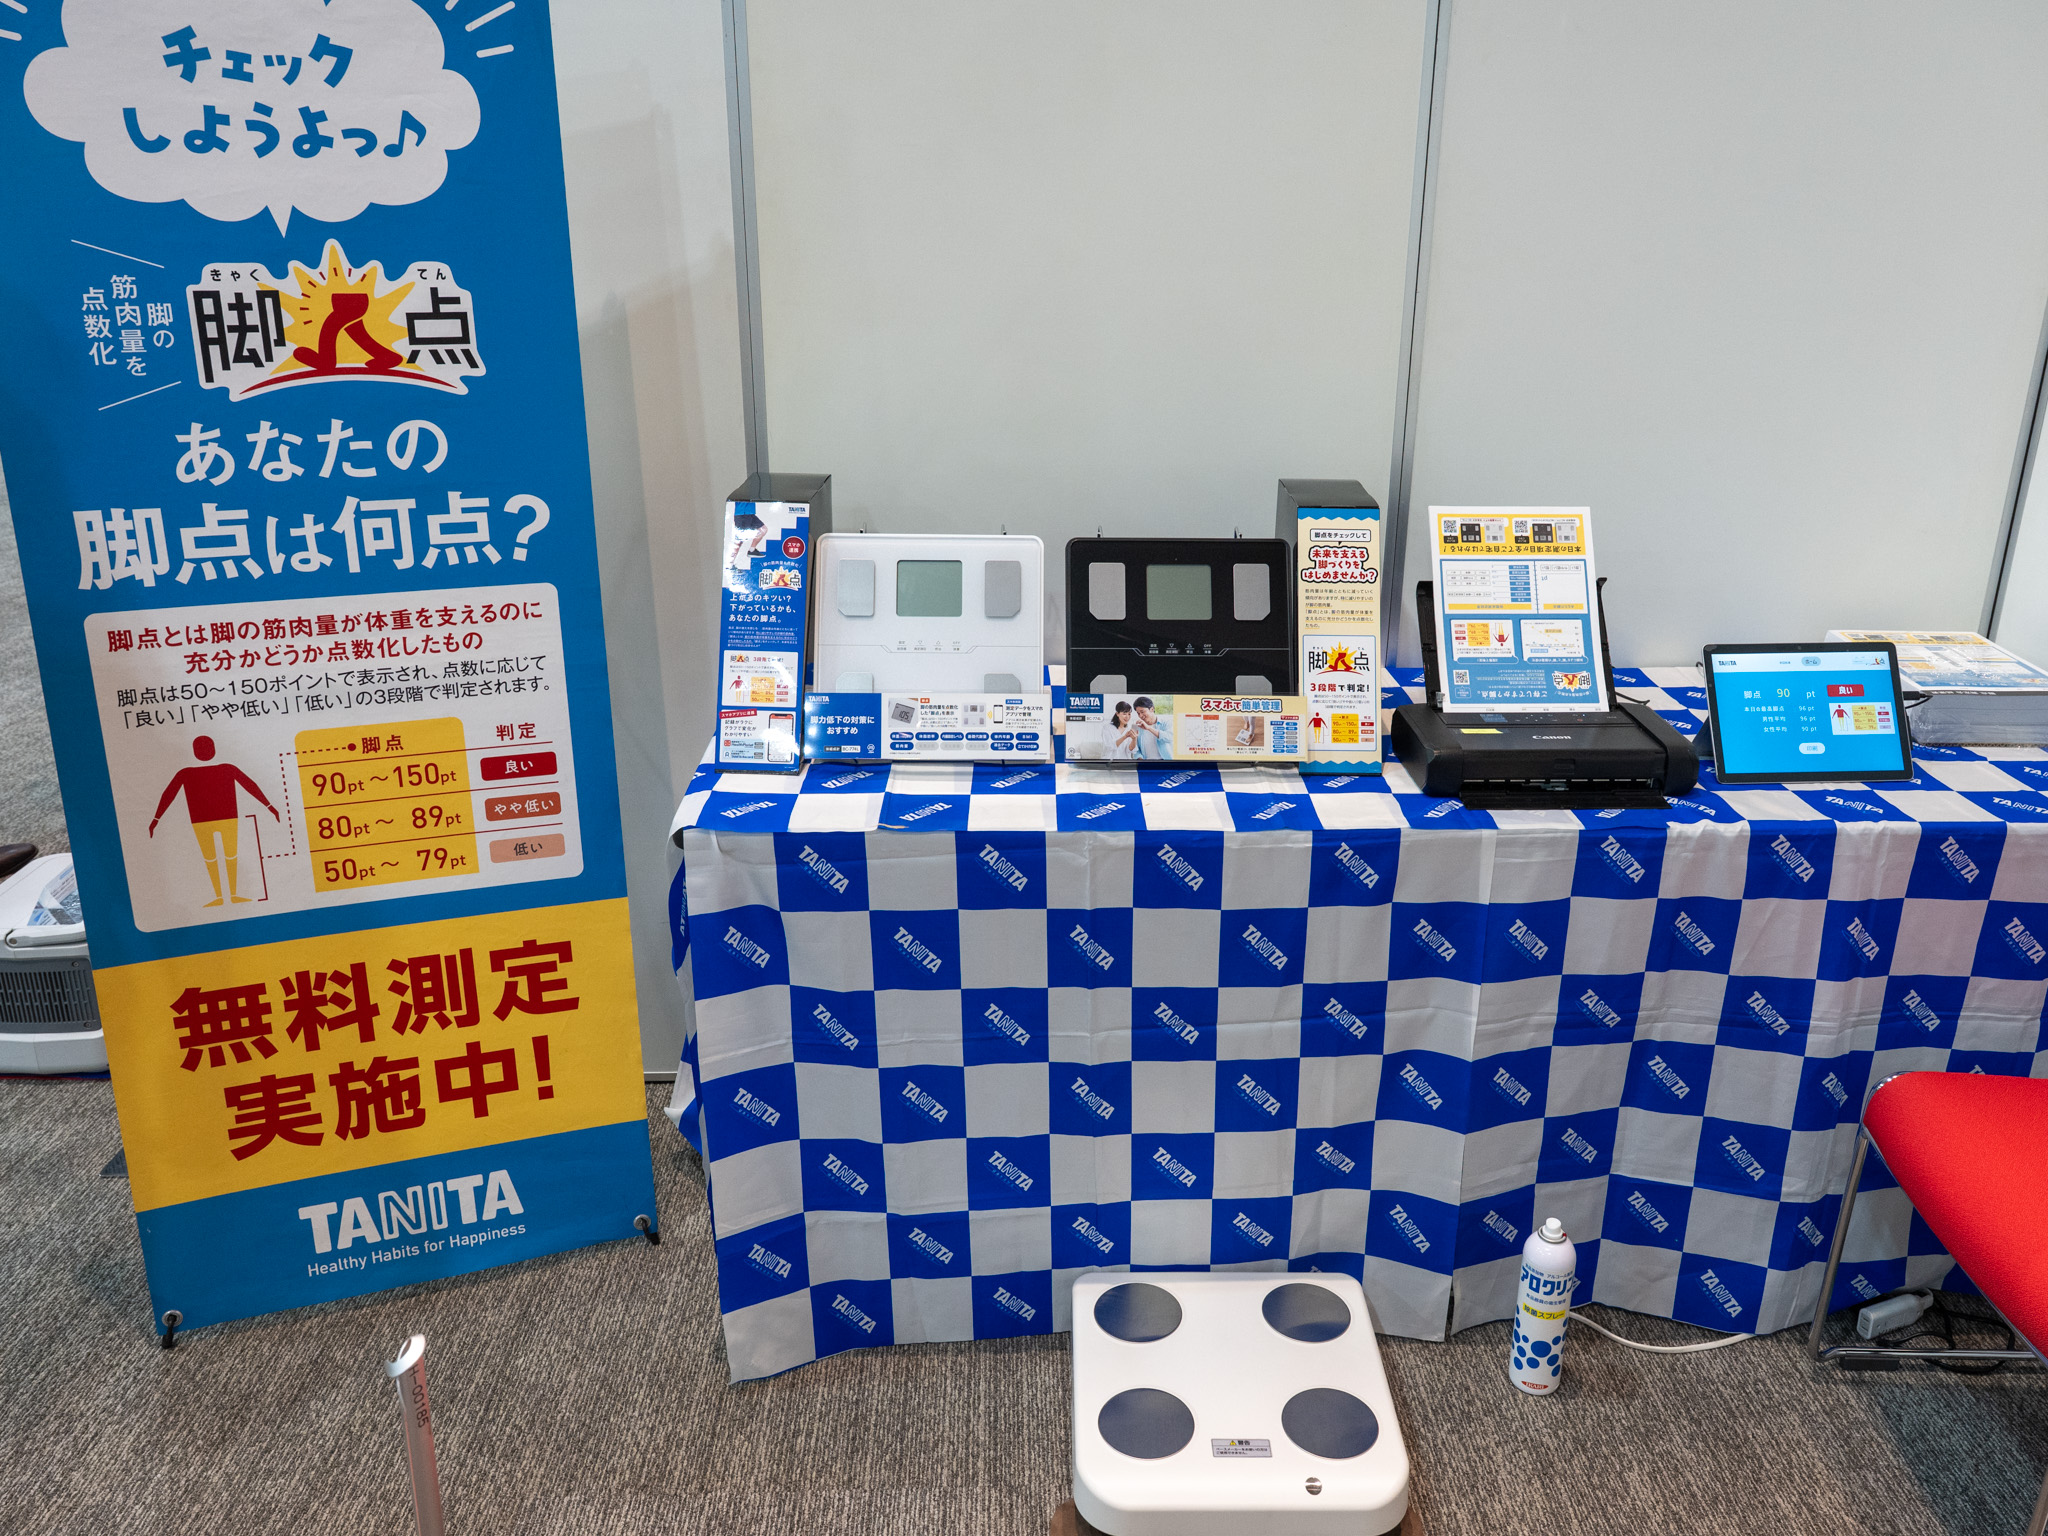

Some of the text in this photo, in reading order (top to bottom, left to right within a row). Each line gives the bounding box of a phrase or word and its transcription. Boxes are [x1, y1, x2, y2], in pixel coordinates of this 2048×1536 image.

[162, 24, 354, 89] チェック
[210, 267, 447, 282] きゃく てん
[81, 287, 116, 366] 点数化
[110, 274, 147, 377] 筋肉量を
[146, 303, 175, 349] 脚の
[175, 418, 449, 487] あなたの
[1312, 549, 1366, 559] 未来を支える
[1318, 561, 1360, 569] 脚づくりを
[107, 600, 544, 653] 脚点とは脚の筋肉量が体重を支えるのに
[184, 631, 484, 674] 充分かどうか点数化したもの
[1070, 697, 1100, 706] TANITA
[1202, 699, 1282, 711] スマホで簡単管理
[1743, 688, 1816, 700] 脚点 90 pt
[1839, 685, 1853, 695] 良い
[361, 721, 537, 754] 脚点 判定
[811, 715, 875, 724] 脚力低下の対策に
[827, 727, 858, 735] おすすめ
[504, 758, 534, 774] 良い
[492, 797, 555, 816] やや低い
[1825, 796, 1884, 814] TANITA
[513, 840, 544, 856] 低い
[799, 845, 849, 893] TANITA
[980, 844, 1028, 891] TANITA
[1157, 844, 1204, 891] TANITA
[1335, 842, 1379, 889] TANITA
[1601, 835, 1645, 883] TANITA
[1771, 834, 1814, 882] TANITA
[1940, 836, 1979, 883] TANITA
[724, 926, 770, 968] TANITA
[894, 927, 942, 973] TANITA
[1070, 925, 1114, 970] TANITA
[1242, 925, 1287, 970] TANITA
[1413, 919, 1456, 961] TANITA
[1509, 919, 1548, 960] TANITA
[1675, 912, 1715, 955] TANITA
[1847, 917, 1879, 960] TANITA
[2005, 917, 2046, 964] TANITA
[169, 939, 581, 1073] 無料測定
[813, 1004, 859, 1050] TANITA
[984, 1003, 1030, 1045] TANITA
[1154, 1002, 1199, 1044] TANITA
[1324, 998, 1367, 1039] TANITA
[1580, 989, 1621, 1027] TANITA
[1747, 991, 1790, 1035] TANITA
[1903, 989, 1940, 1031] TANITA
[1071, 1077, 1114, 1119] TANITA
[1237, 1074, 1280, 1115] TANITA
[1400, 1064, 1442, 1110] TANITA
[1494, 1067, 1531, 1105] TANITA
[1648, 1056, 1690, 1099] TANITA
[734, 1088, 780, 1126] TANITA
[902, 1081, 948, 1122] TANITA
[1316, 1141, 1355, 1173] TANITA
[1561, 1128, 1597, 1163] TANITA
[1722, 1135, 1765, 1181] TANITA
[823, 1153, 868, 1195] TANITA
[989, 1151, 1033, 1191] TANITA
[1153, 1147, 1196, 1187] TANITA
[298, 1168, 524, 1254] TANITA
[1233, 1212, 1274, 1246] TANITA
[1390, 1204, 1430, 1253] TANITA
[1483, 1210, 1518, 1242] TANITA
[1628, 1191, 1669, 1232] TANITA
[307, 1223, 526, 1278] Healthy Habits for Happiness
[909, 1228, 953, 1264] TANITA
[1072, 1217, 1114, 1253] TANITA
[748, 1244, 791, 1278] TANITA
[832, 1294, 876, 1333] TANITA
[993, 1287, 1035, 1321] TANITA
[1701, 1269, 1742, 1317] TANITA
